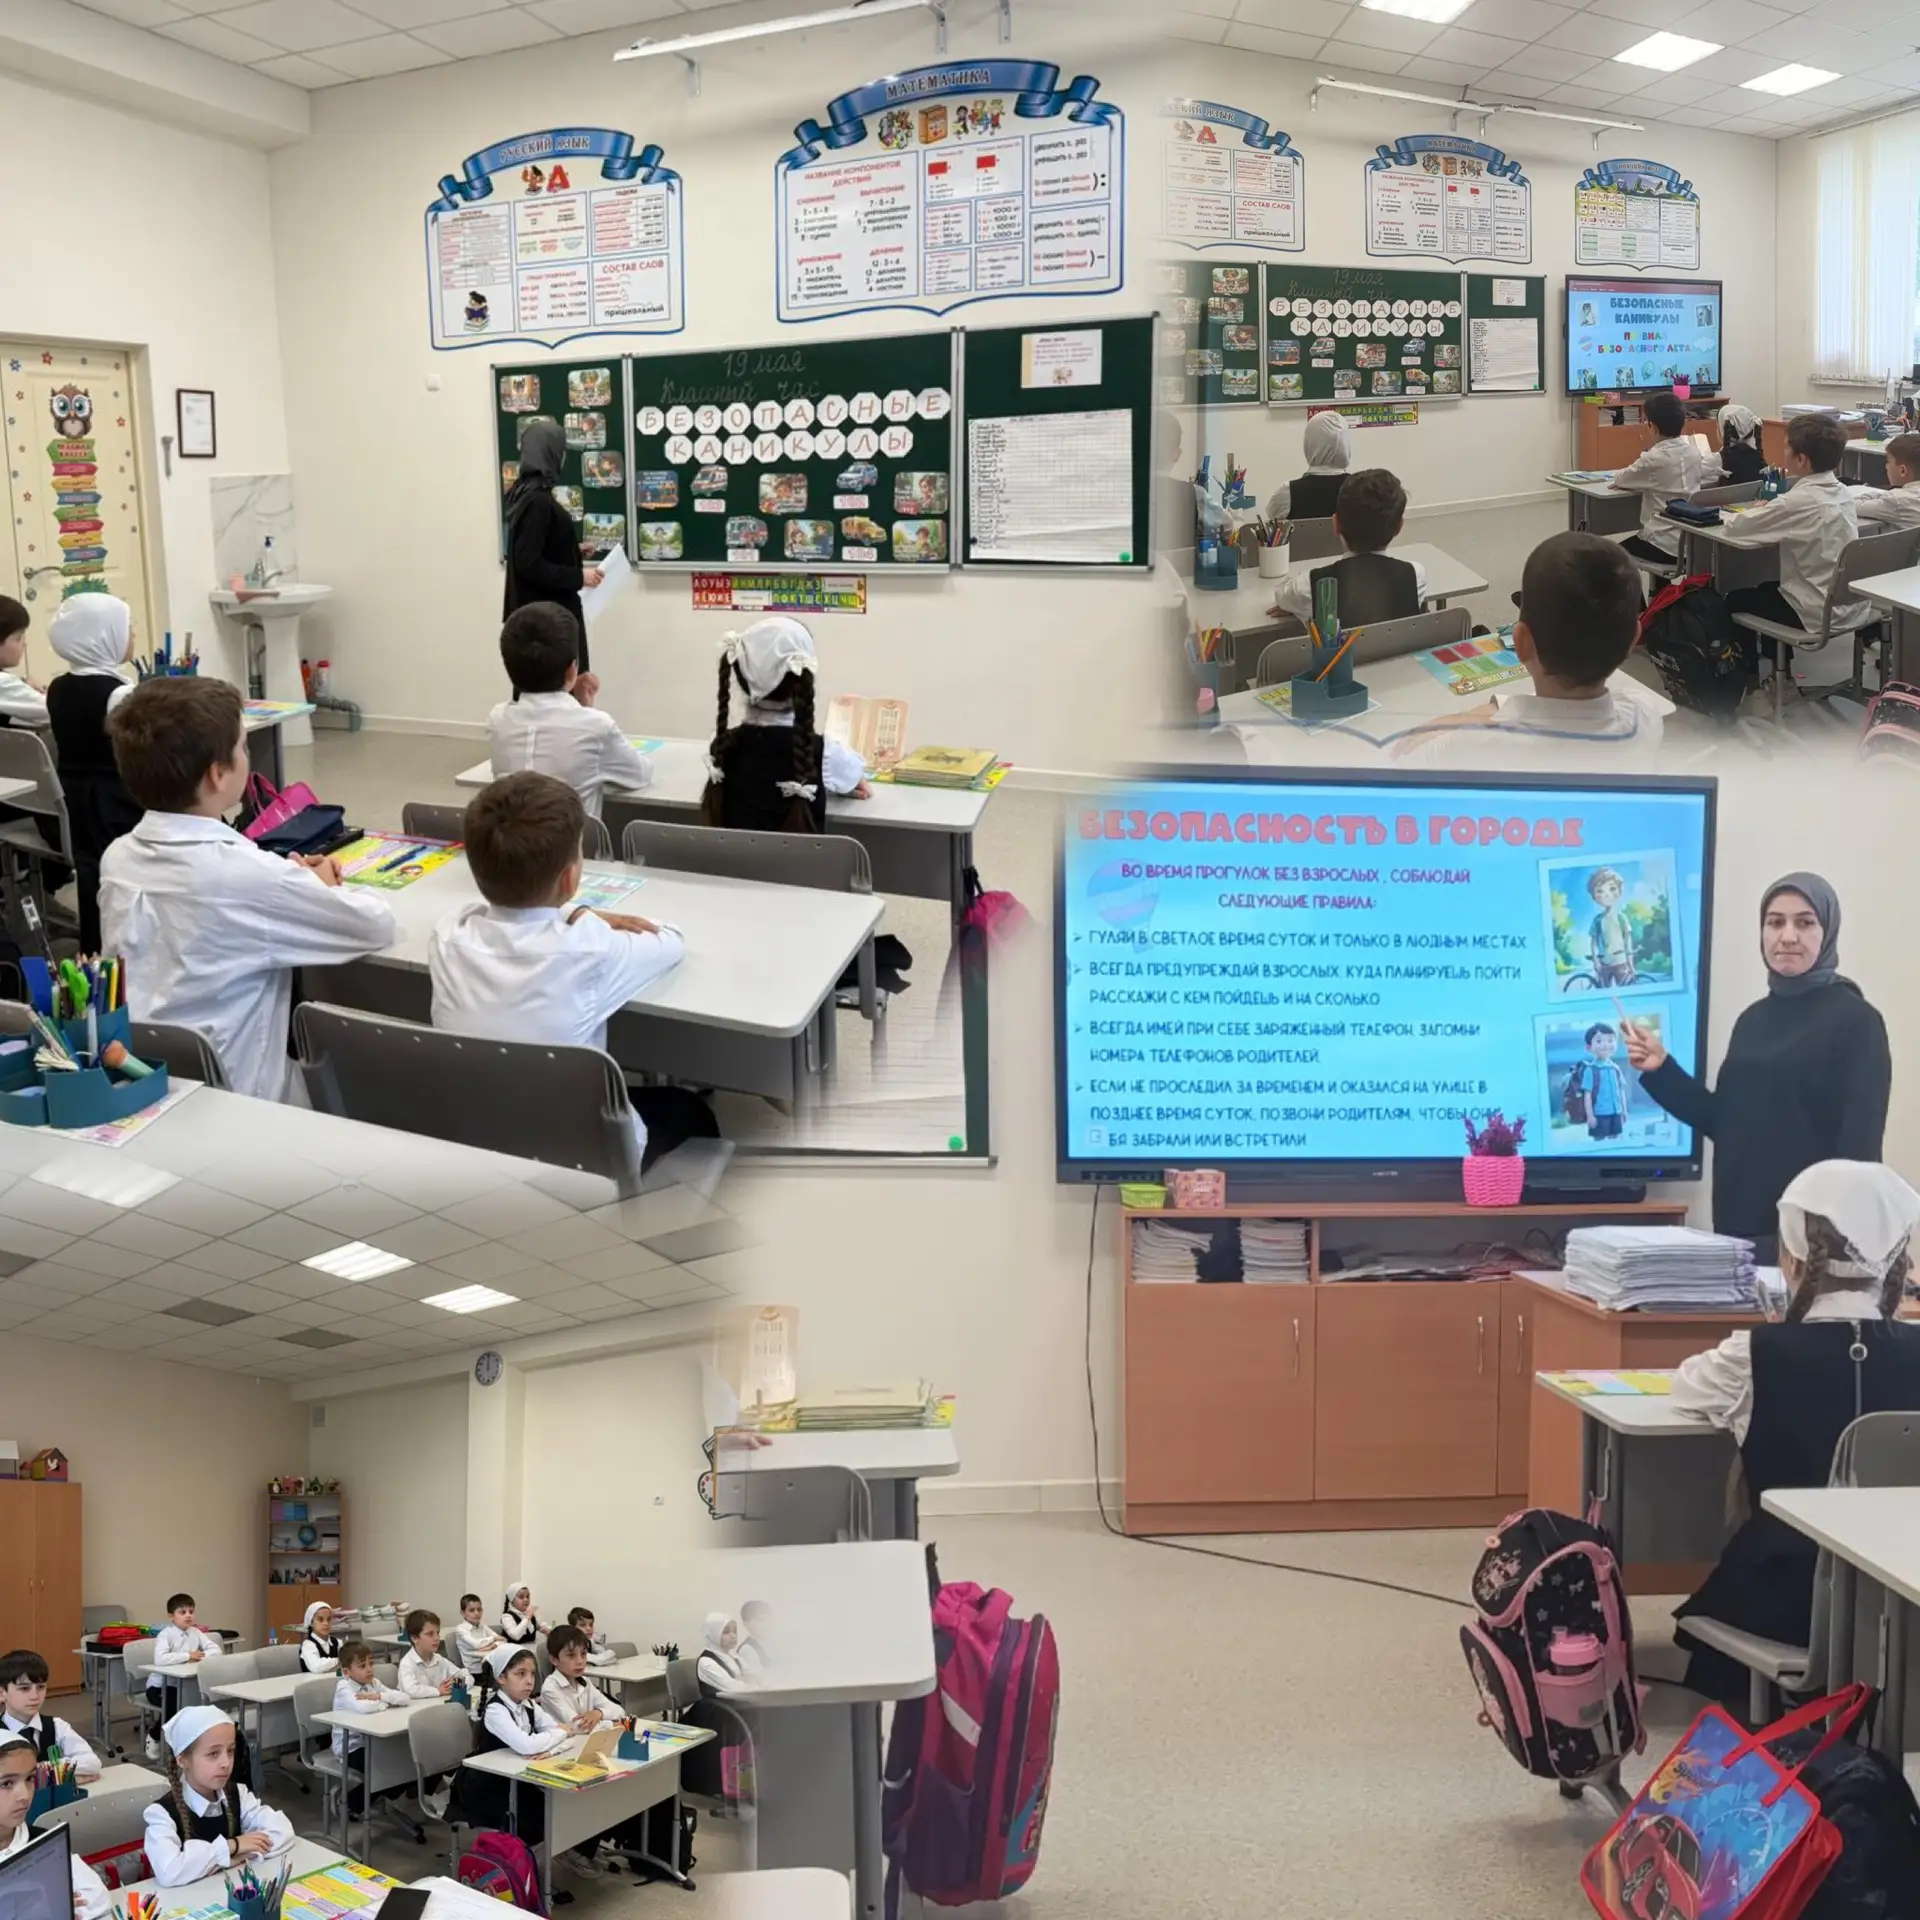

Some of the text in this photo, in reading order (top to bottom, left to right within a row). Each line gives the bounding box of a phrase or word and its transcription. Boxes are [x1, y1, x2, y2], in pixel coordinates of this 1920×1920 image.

[887, 68, 991, 98] МАТЕМАТИКА
[1206, 108, 1235, 121] ЯЗЫК
[1427, 140, 1477, 153] МАТЕМАТИКА
[1242, 200, 1271, 208] СОСТАВ
[1243, 229, 1290, 238] пришкольный
[602, 260, 664, 274] СОСТАВ СЛОВ
[1333, 268, 1386, 286] 19 мая
[605, 305, 664, 317] пришкольный
[1610, 297, 1684, 310] БЕЗОПАСНЫЕ
[1615, 313, 1680, 325] КАНИКУЛЫ
[723, 350, 806, 378] 19 мая
[661, 377, 821, 404] Классный час
[644, 393, 942, 429] БЕЗОПАСНЫЕ
[672, 432, 907, 460] КАНИКУЛЫ
[1079, 809, 1584, 848] БЕЗОПАСНОСТЬ В ГОРОДЕ
[1121, 863, 1142, 878] ВО
[1145, 864, 1193, 879] ВРЕМЯ
[1196, 864, 1271, 881] ПРОГУЛОК
[1274, 866, 1299, 881] БЕЗ
[1302, 867, 1379, 882] ВЗРОСЛЫХ
[1390, 867, 1471, 884] СОБЛЮДАЙ
[1218, 894, 1377, 909] СЛЕДУЮЩИЕ ПРАВИЛА:
[1089, 929, 1134, 945] ГУЛЯЙ
[1138, 931, 1148, 945] В
[1152, 931, 1217, 945] СВЕТЛОЕ
[1219, 931, 1265, 946] ВРЕМЯ
[1268, 932, 1316, 947] СУТОК
[1319, 933, 1329, 947] И
[1333, 933, 1390, 948] ТОЛЬКО
[1393, 934, 1402, 947] В
[1472, 934, 1527, 949] МЕСТАХ
[1090, 961, 1143, 977] ВСЕГДА
[1147, 961, 1259, 978] ПРЕДУПРЕЖДАЙ
[1346, 964, 1382, 980] КУДА
[1385, 964, 1471, 980] ПЛАНИРУЕШЬ
[1474, 964, 1522, 980] ПОЙТИ
[1090, 989, 1380, 1006] РАССКАЖИ С КЕМ ПОЙДЕШЬ И НА СКОЛЬКО
[1090, 1020, 1144, 1035] ВСЕГДА
[1146, 1020, 1183, 1035] ИМЕЙ
[1187, 1021, 1214, 1035] ПРИ
[1217, 1021, 1250, 1035] СЕБЕ
[1254, 1020, 1346, 1036] ЗАРЯЖЕННЫЙ
[1419, 1022, 1481, 1036] ЗАПОМНИ
[1090, 1049, 1145, 1063] НОМЕРА
[1151, 1048, 1234, 1063] ТЕЛЕФОНОВ
[1090, 1079, 1488, 1095] ЕСЛИ НЕ ПРОСЛЕДИЛ ЗА ВРЕМЕНЕМ И ОКАЗАЛСЯ НА УЛИЦЕ В
[1090, 1106, 1154, 1121] ПОЗДНЕЕ
[1157, 1107, 1201, 1120] ВРЕМЯ
[1260, 1107, 1325, 1121] ПОЗВОНИ
[1418, 1106, 1467, 1121] ЧТОБЫ
[1132, 1133, 1190, 1147] ЗАБРАЛИ
[1195, 1133, 1222, 1147] ИЛИ
[1225, 1133, 1307, 1147] ВСТРЕТИЛИ
